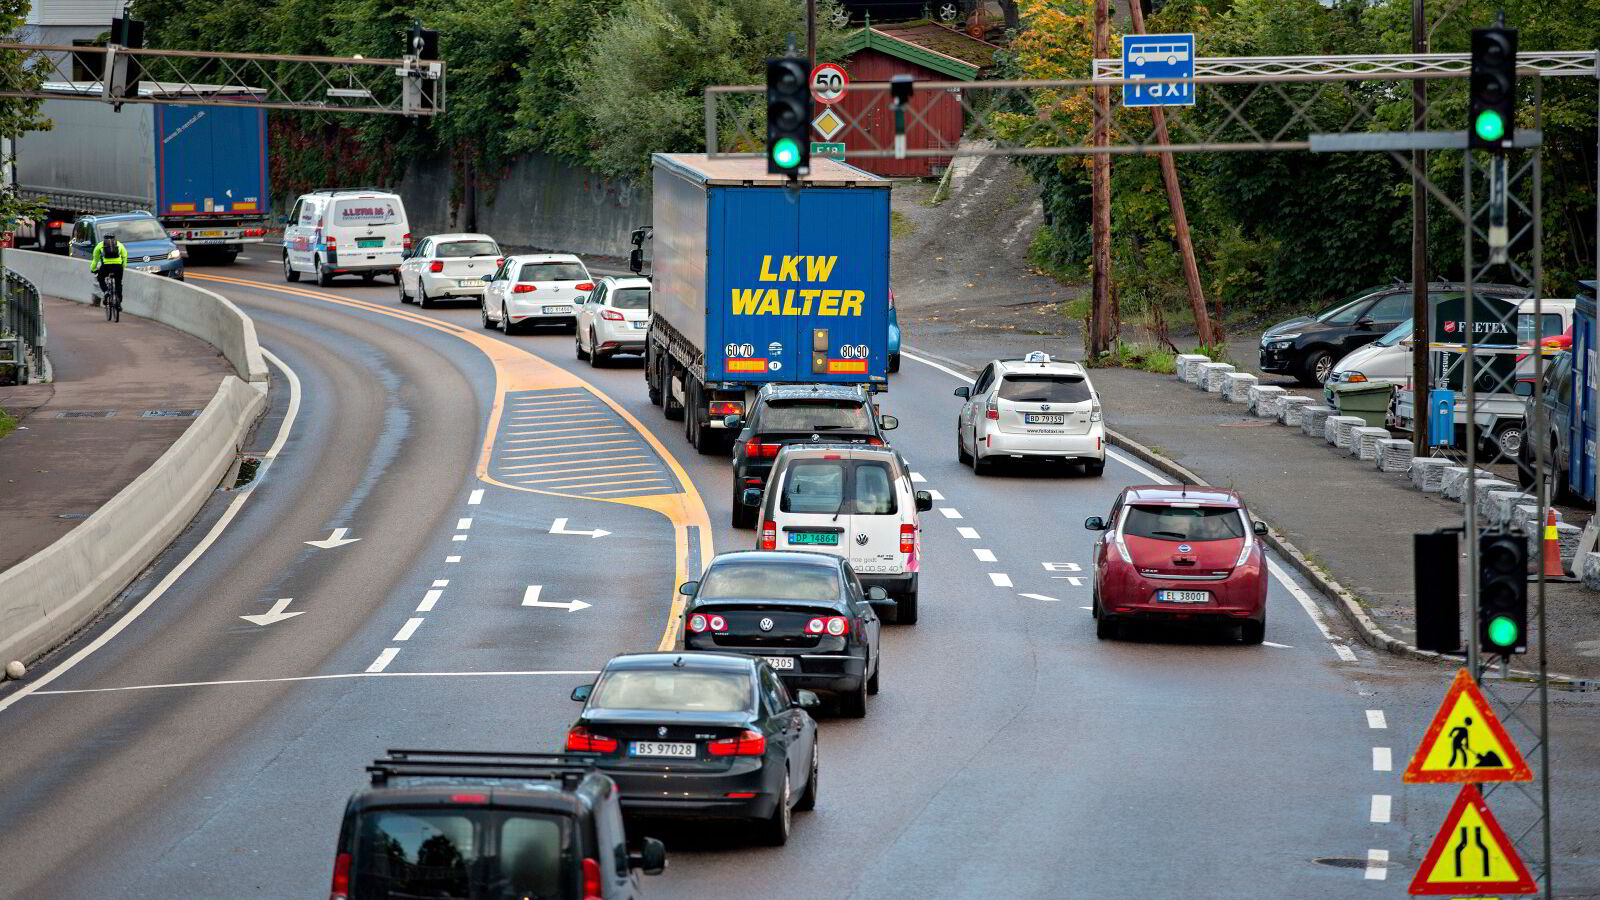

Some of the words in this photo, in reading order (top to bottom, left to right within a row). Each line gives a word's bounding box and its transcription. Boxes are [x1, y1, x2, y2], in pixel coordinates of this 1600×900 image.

[816, 74, 842, 93] 50
[1130, 72, 1188, 98] Taxi
[759, 254, 838, 282] LKW
[732, 288, 866, 317] WALTER
[727, 344, 738, 357] 60
[742, 344, 753, 357] 70
[842, 345, 853, 358] 80
[856, 345, 867, 358] 90
[796, 534, 807, 542] DP
[810, 534, 836, 543] 14864
[1167, 592, 1176, 600] EL
[1180, 592, 1205, 601] 38001
[766, 658, 792, 668] 7305
[639, 743, 653, 754] BS
[657, 743, 692, 755] 97028
